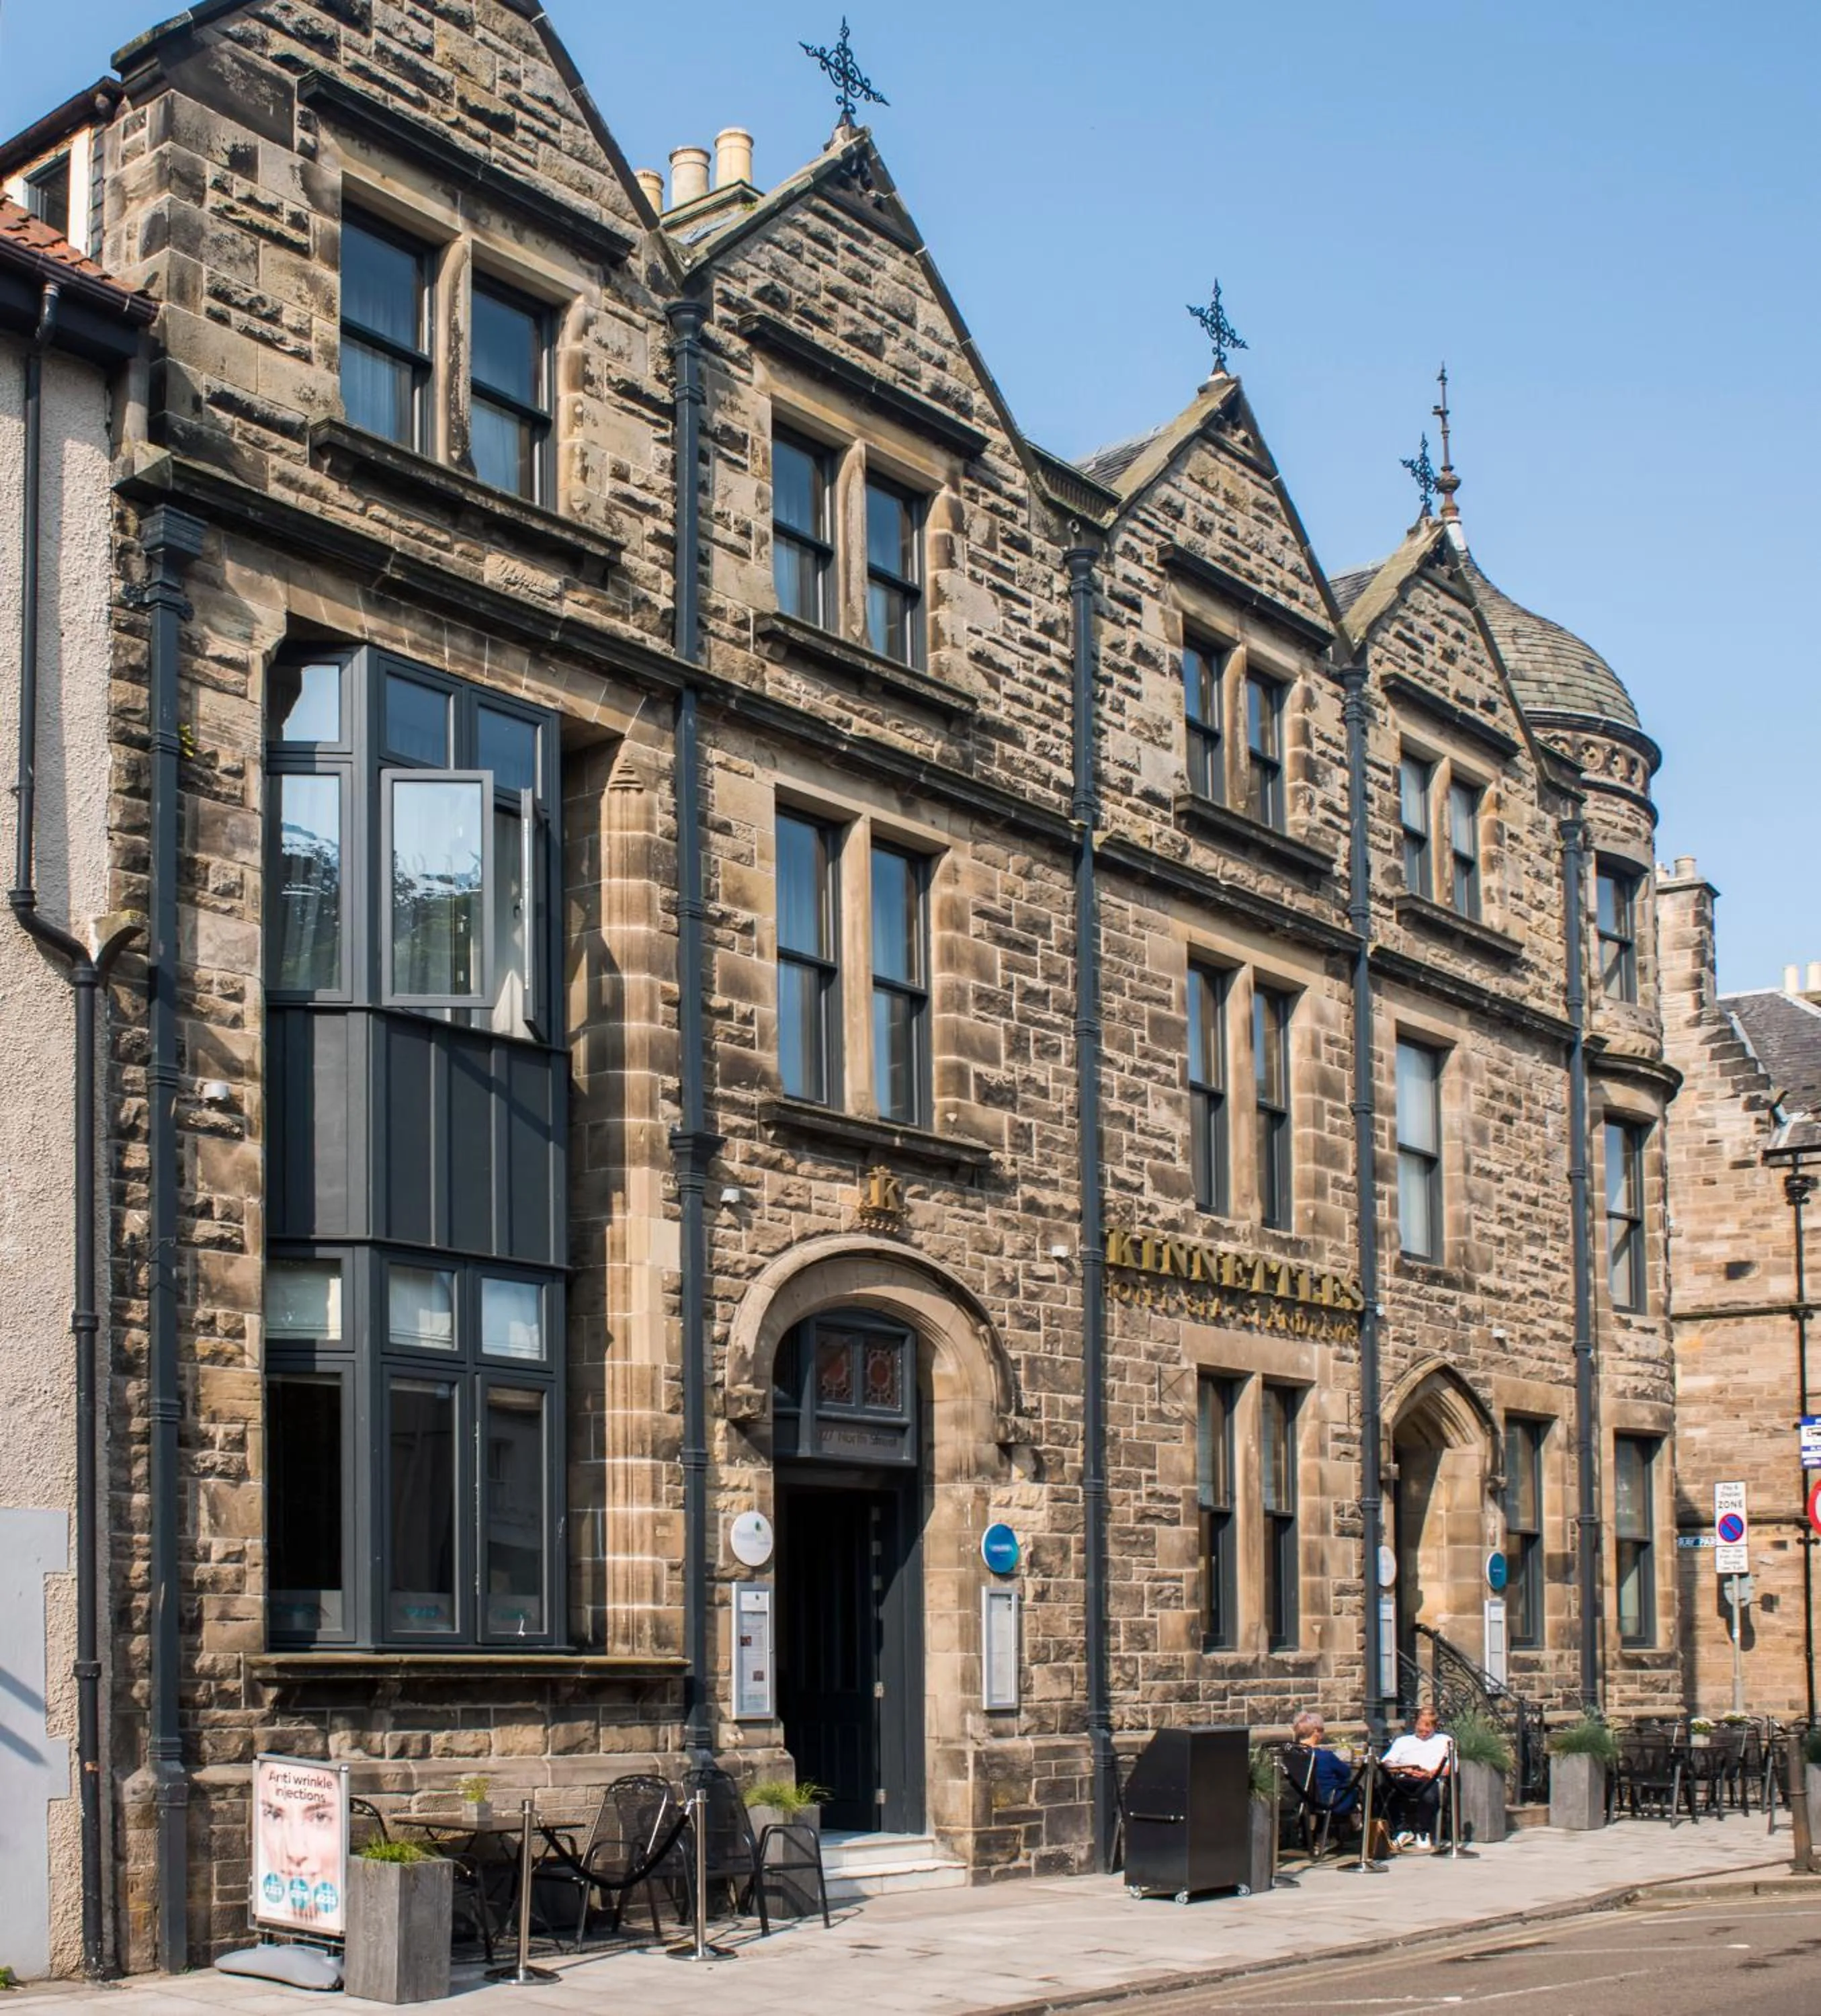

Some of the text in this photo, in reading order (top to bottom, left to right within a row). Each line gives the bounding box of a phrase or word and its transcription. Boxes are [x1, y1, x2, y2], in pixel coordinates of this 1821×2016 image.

[1105, 1227, 1365, 1312] KINNETTLES
[1718, 1500, 1742, 1509] ZONE
[269, 1771, 333, 1790] Anti wrinkle
